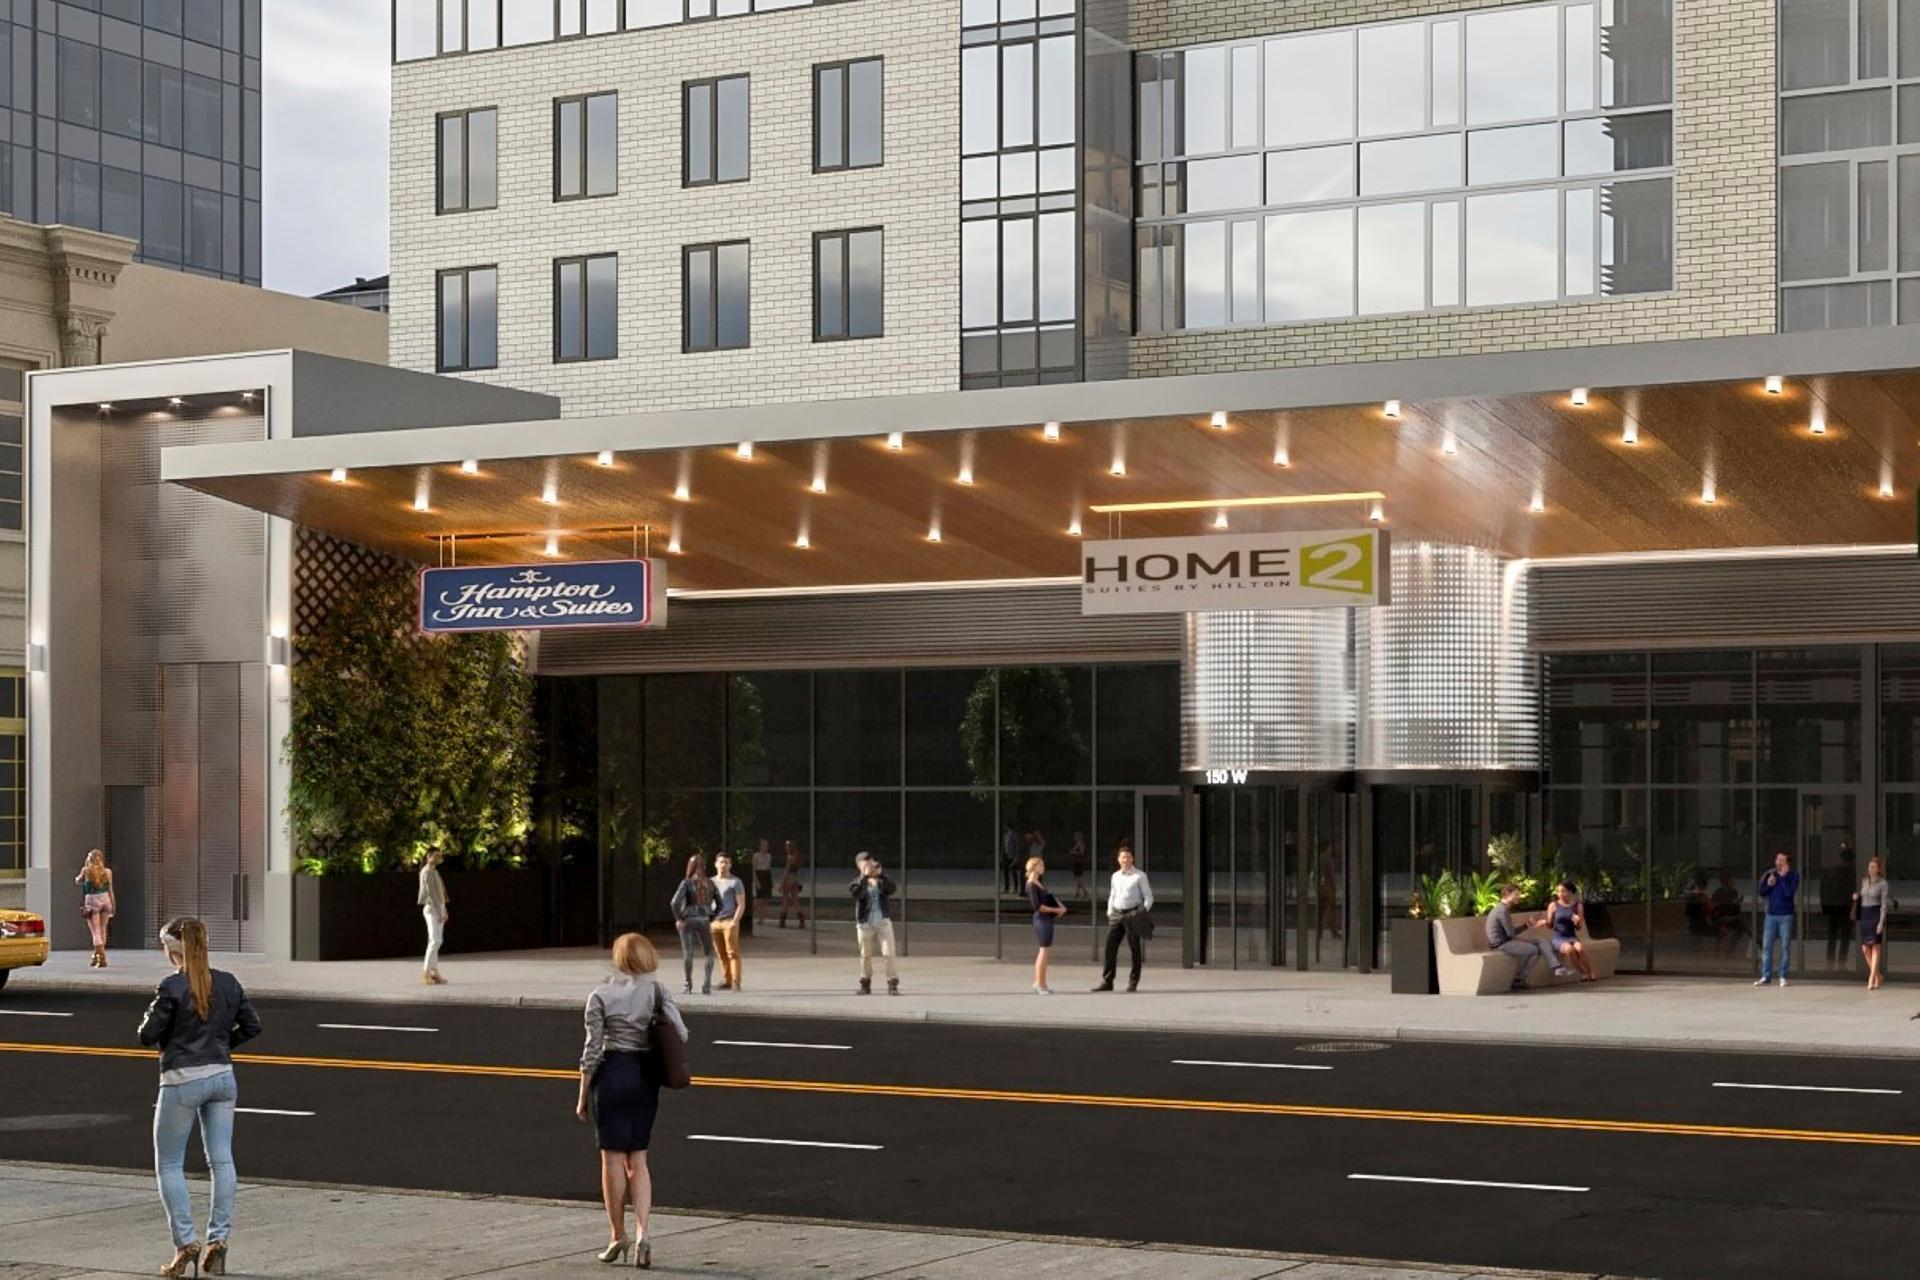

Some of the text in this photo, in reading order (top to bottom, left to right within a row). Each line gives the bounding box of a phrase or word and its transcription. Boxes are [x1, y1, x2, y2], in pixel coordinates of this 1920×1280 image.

[1085, 542, 1363, 590] HOME 2
[440, 582, 615, 606] Hampton
[1086, 580, 1291, 594] SUITES BY HILTON
[433, 600, 633, 622] Inn & Suites
[1206, 769, 1248, 784] 150 W
